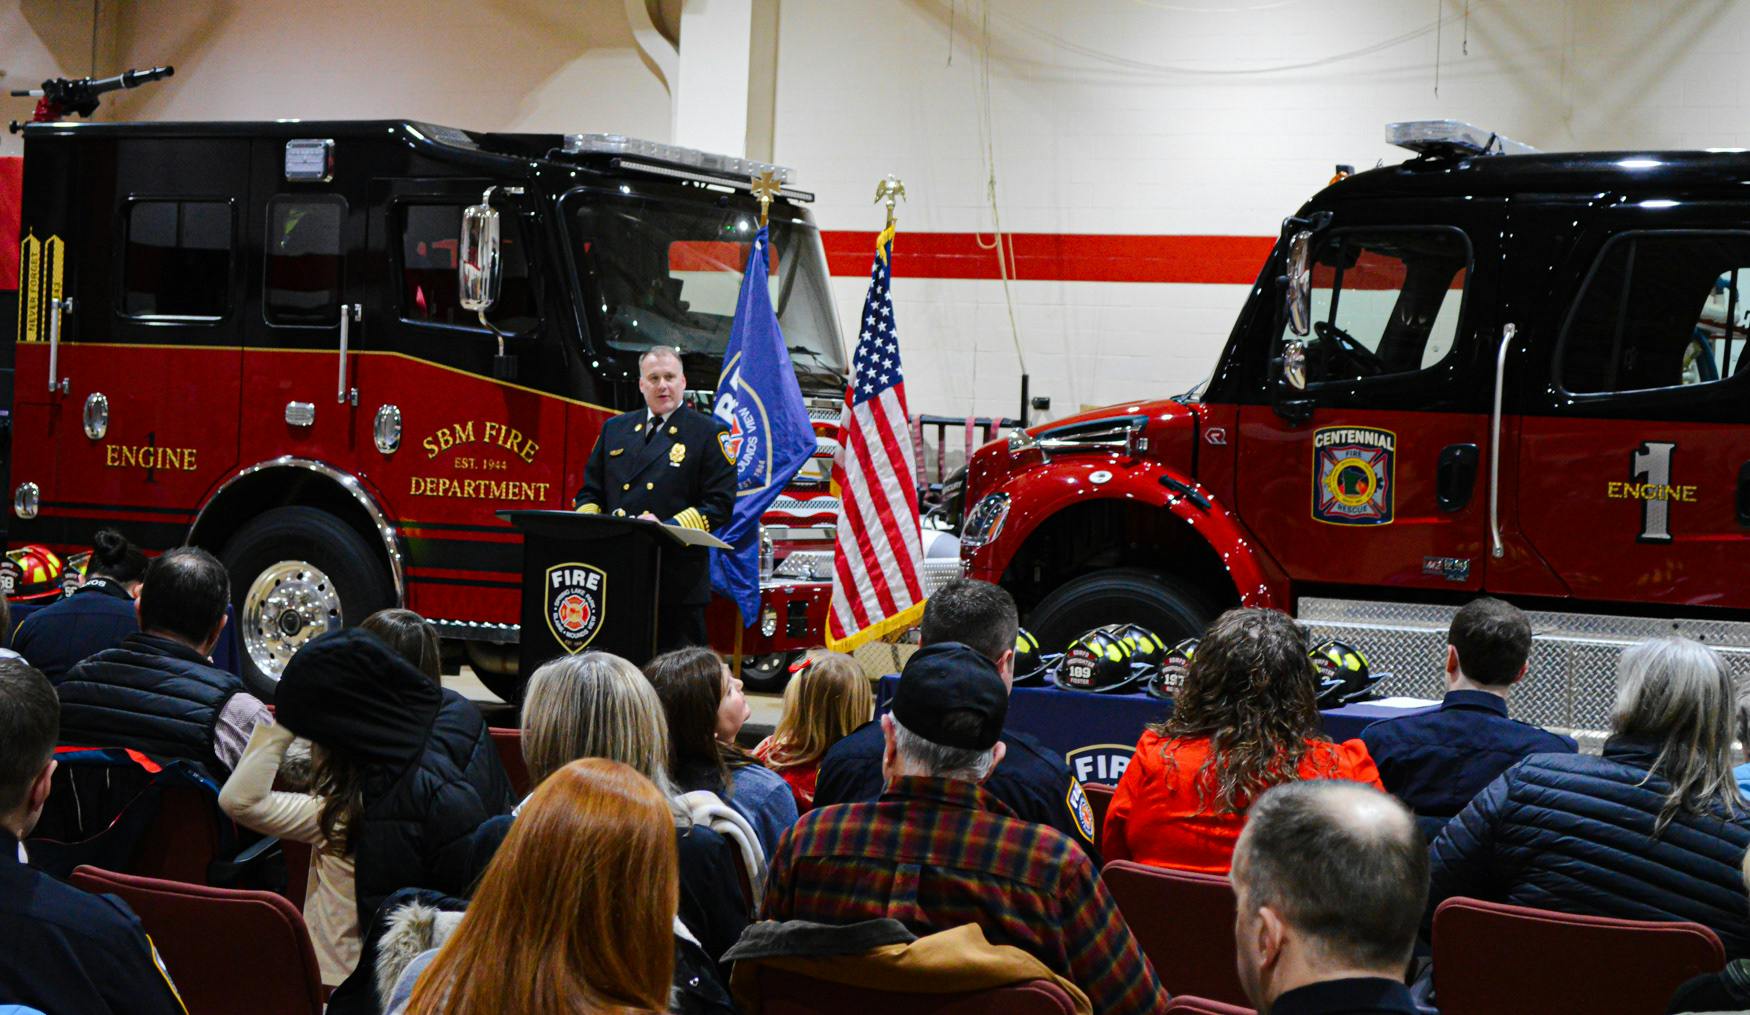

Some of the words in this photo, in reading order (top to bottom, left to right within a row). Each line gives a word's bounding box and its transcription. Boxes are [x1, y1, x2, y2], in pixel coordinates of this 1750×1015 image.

[30, 253, 38, 293] FORGET
[28, 297, 37, 331] NEVER
[738, 406, 757, 434] VIEW
[422, 420, 476, 459] SBM
[483, 421, 540, 464] FIRE
[1315, 429, 1395, 452] CENTENNIAL
[106, 444, 197, 470] ENGINE
[454, 457, 479, 470] EST.
[483, 459, 507, 470] 1944
[737, 435, 758, 473] OUNDS
[1345, 449, 1362, 458] FIRE
[409, 476, 550, 501] DEPARTMENT
[1607, 481, 1698, 503] ENGINE
[1632, 441, 1676, 541] 1
[1337, 503, 1368, 514] RESCUE
[551, 569, 601, 591] FIRE
[570, 587, 586, 596] LAKE
[585, 593, 596, 609] PARK
[1075, 754, 1131, 782] FIR
